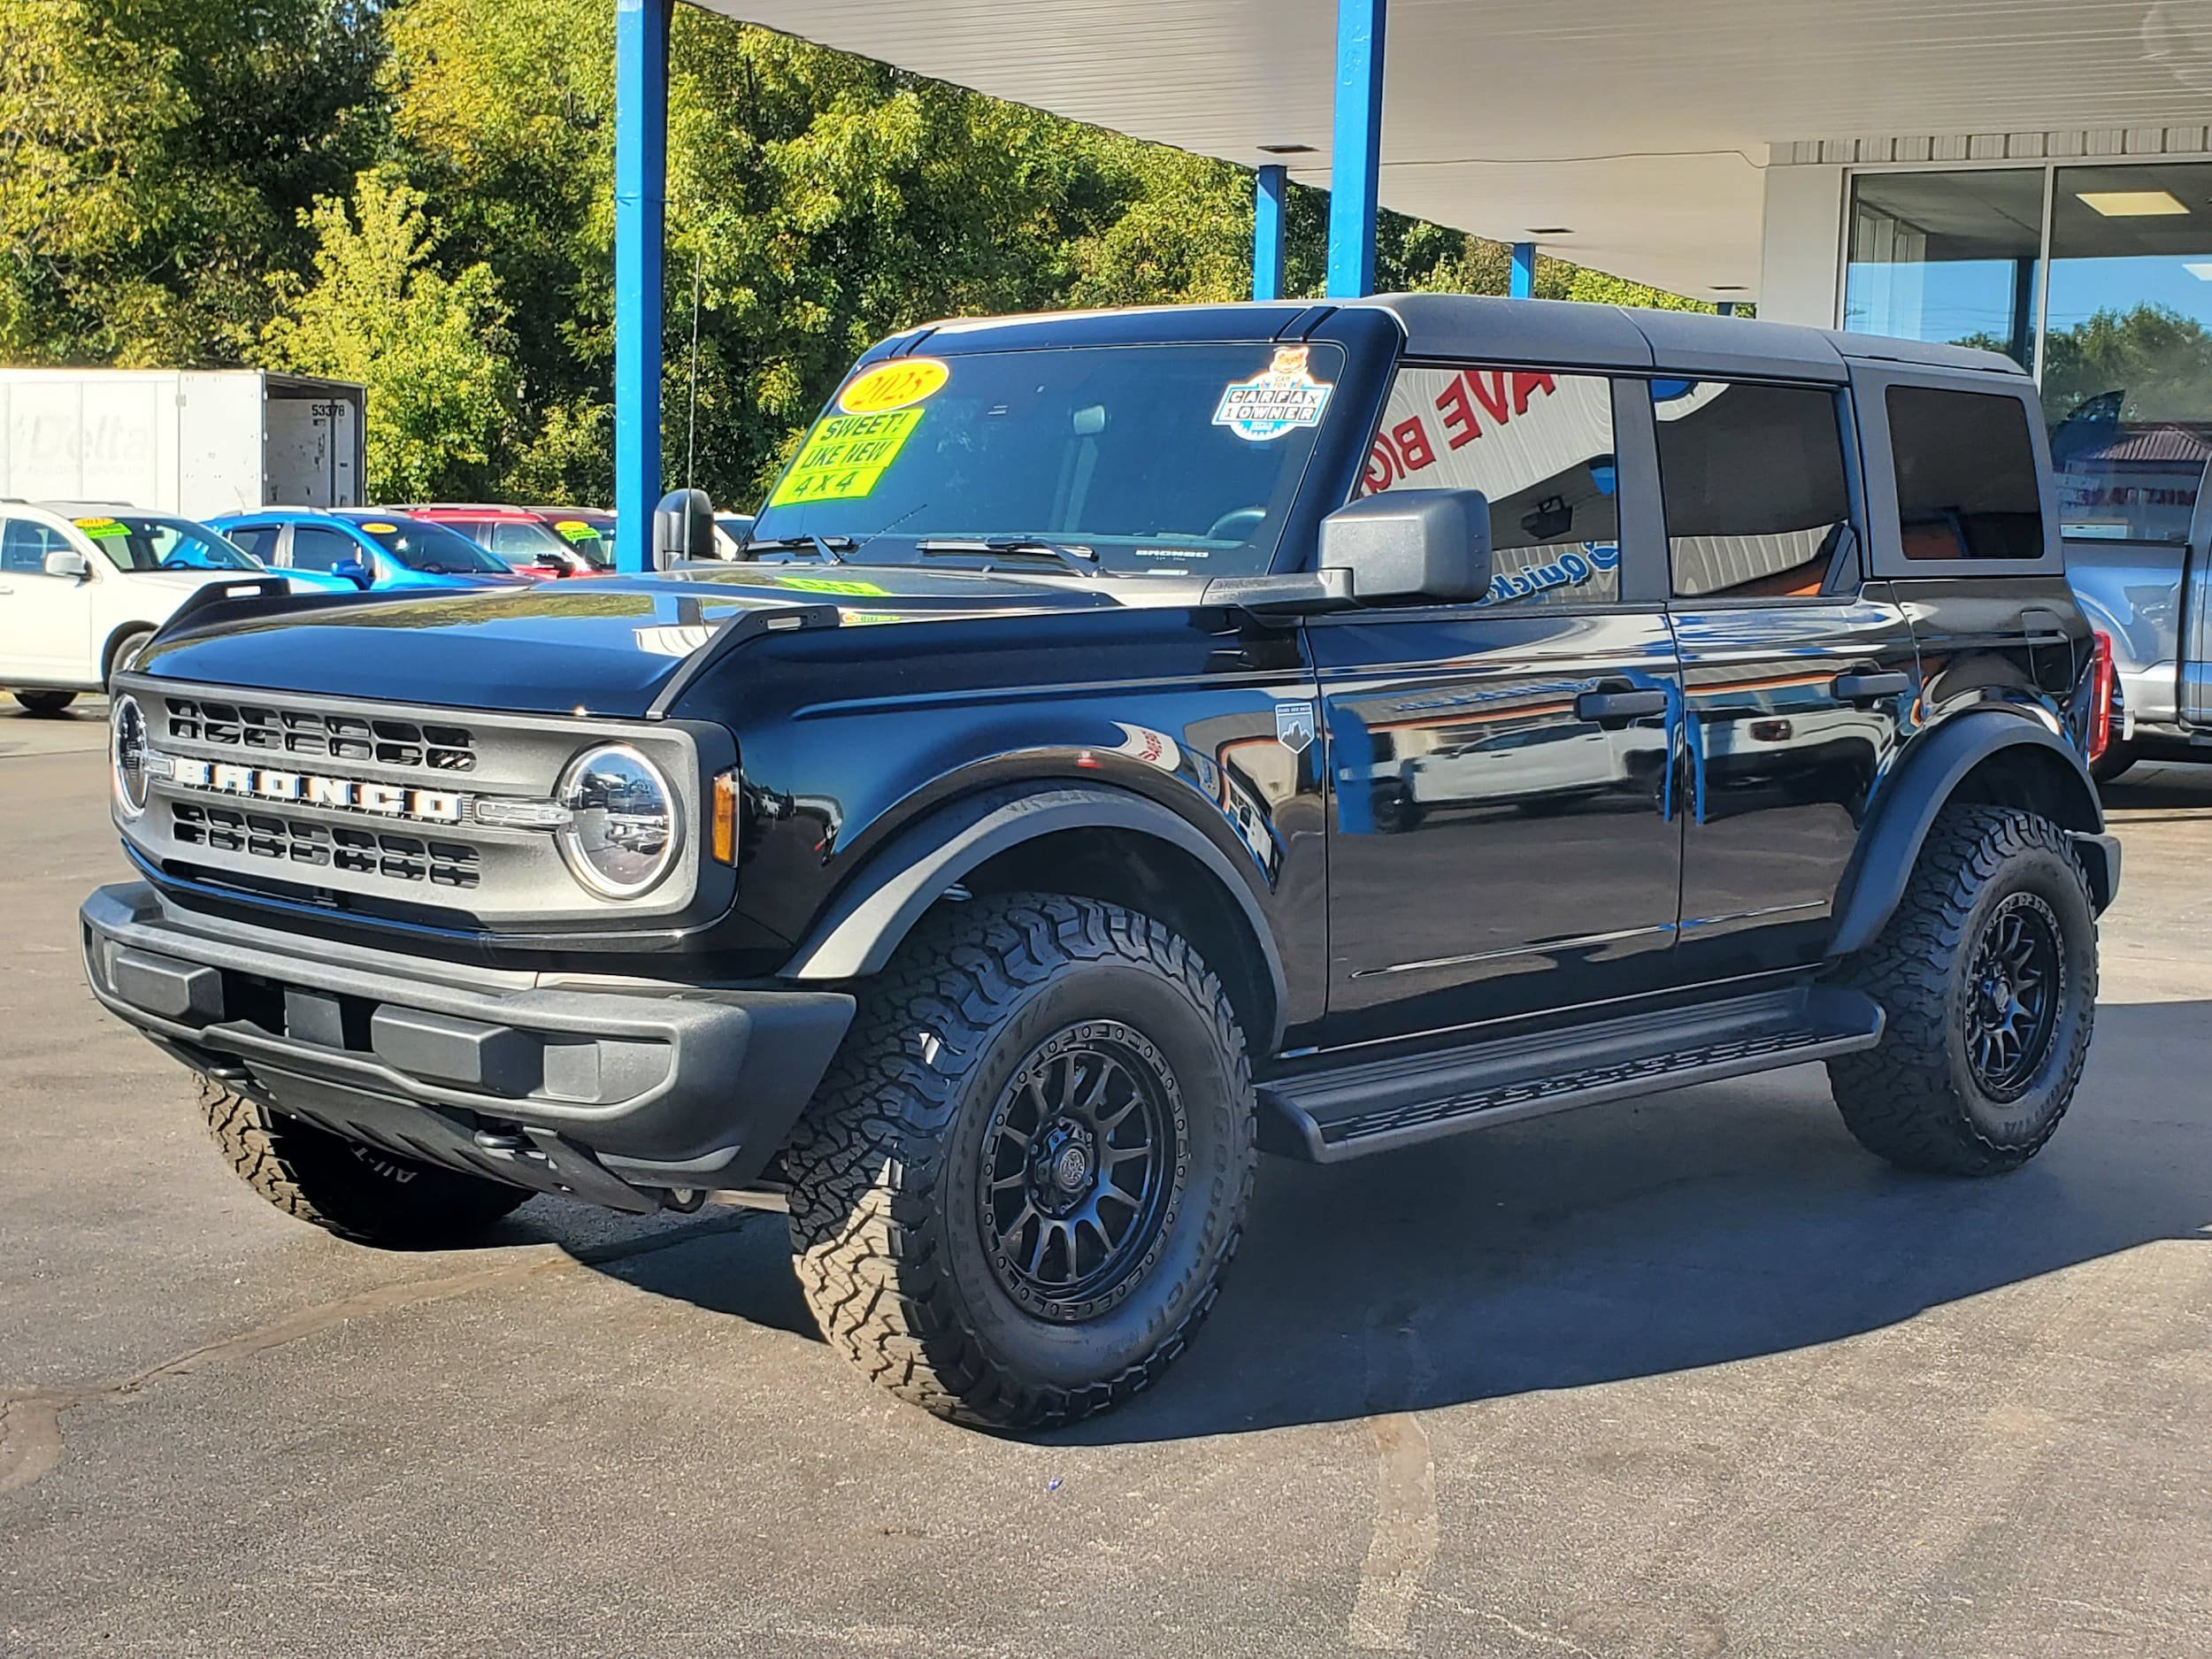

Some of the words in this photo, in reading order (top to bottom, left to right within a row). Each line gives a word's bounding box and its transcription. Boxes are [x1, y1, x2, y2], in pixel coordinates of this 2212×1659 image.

[852, 369, 934, 406] 2025
[1229, 390, 1319, 404] CARFAX
[311, 404, 345, 417] 53378
[1238, 407, 1317, 420] OWNER
[821, 413, 909, 441] SWEET!
[841, 441, 895, 464] NEW
[174, 757, 463, 820] BRONCO
